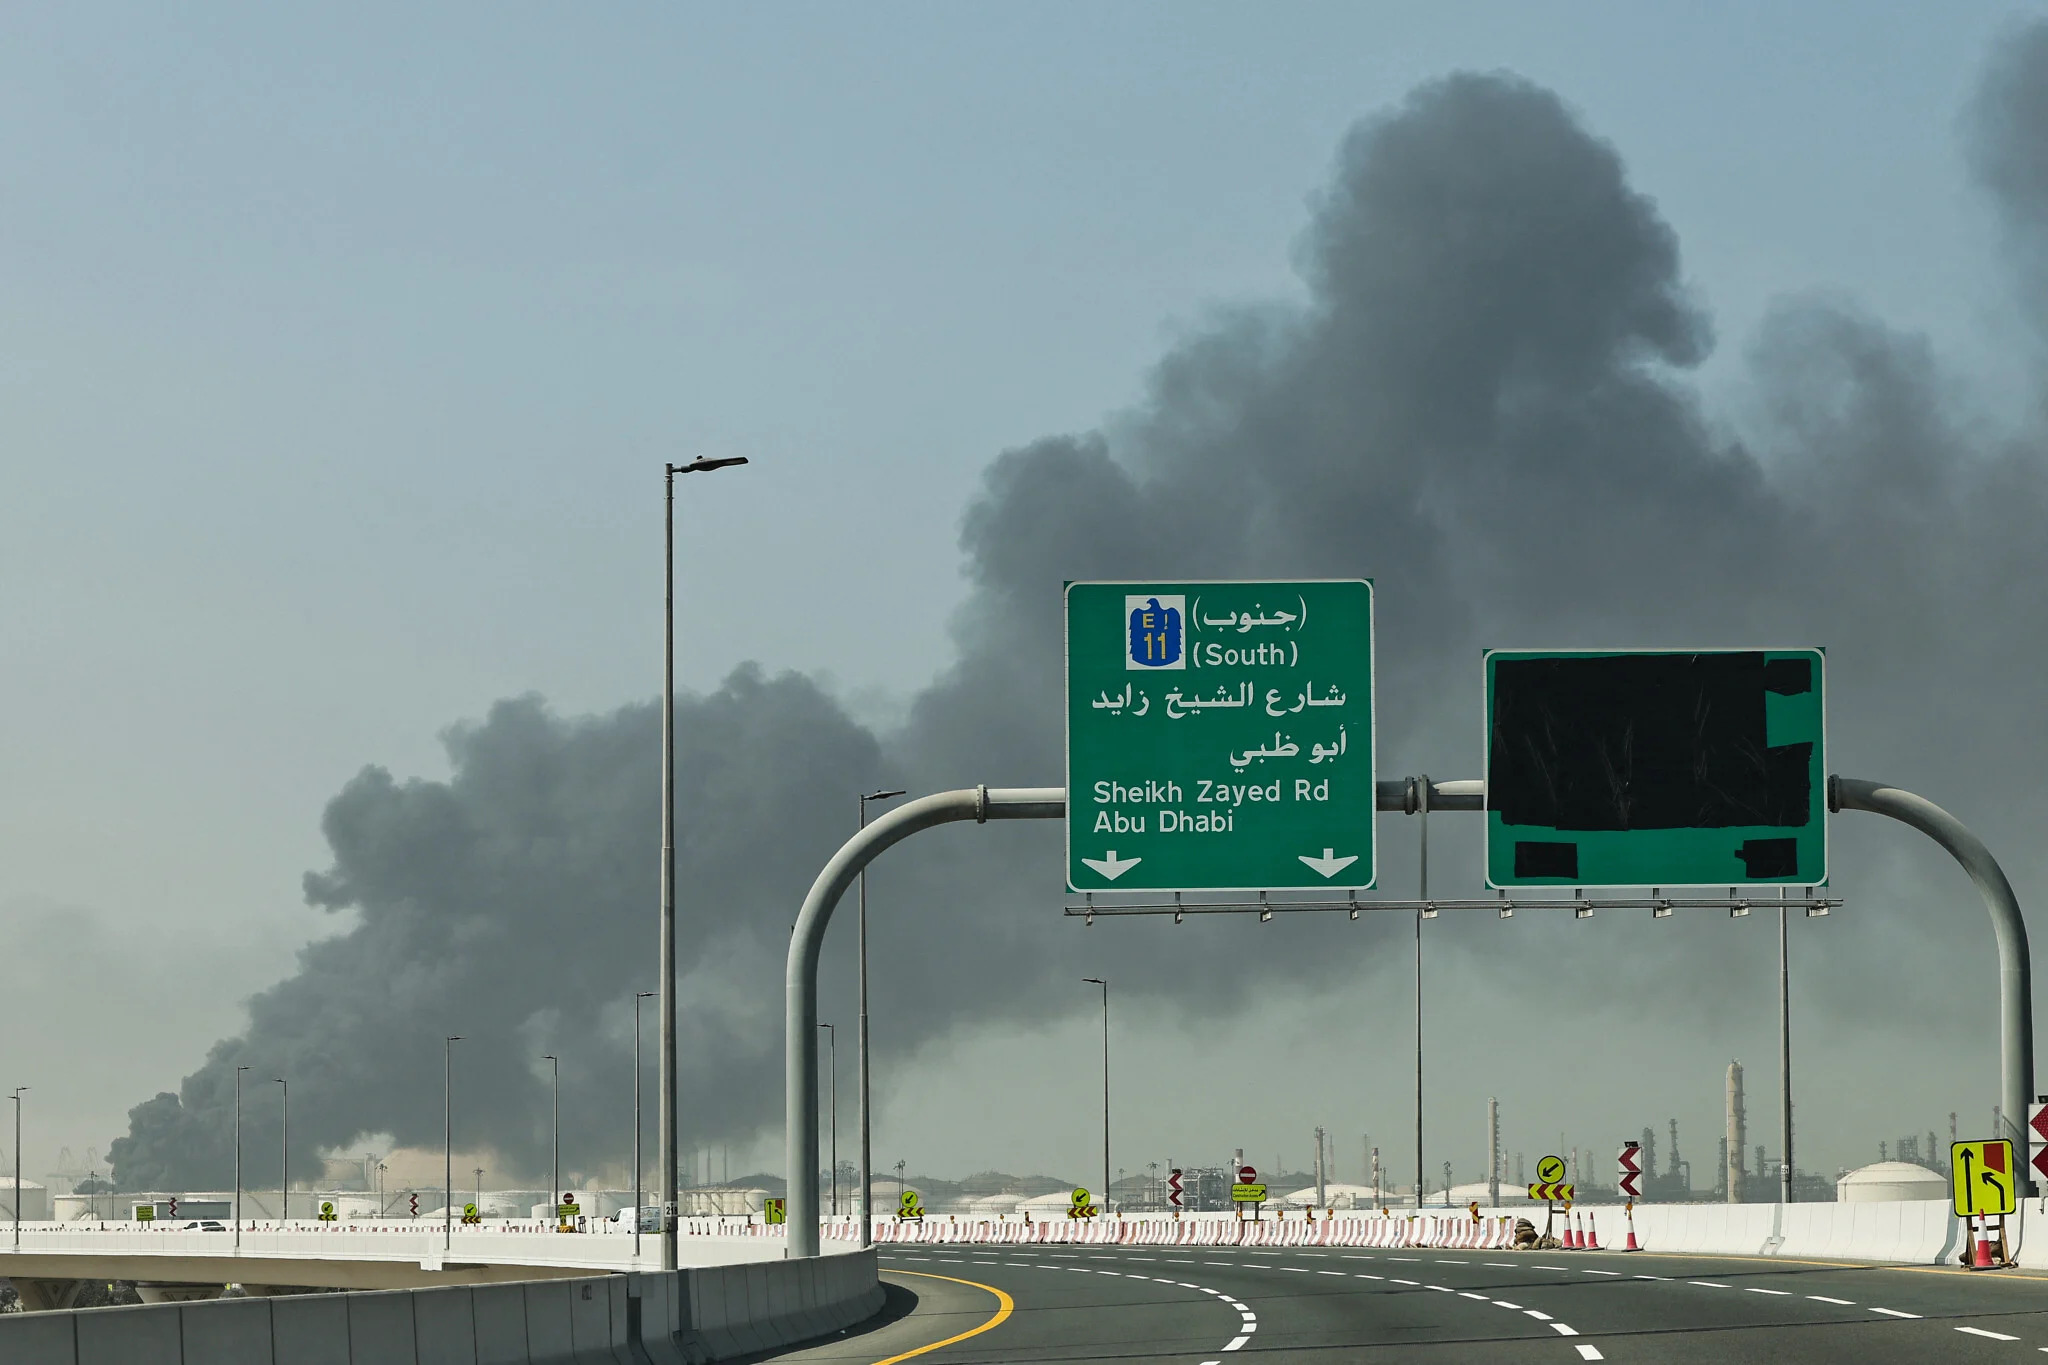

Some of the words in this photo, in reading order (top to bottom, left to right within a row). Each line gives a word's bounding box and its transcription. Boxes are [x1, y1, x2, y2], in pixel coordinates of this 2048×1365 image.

[1143, 614, 1154, 628] E
[1193, 595, 1306, 633] (جنوب)
[1144, 633, 1165, 659] 11
[1193, 641, 1297, 667] (South)
[1092, 682, 1149, 716] زايد
[1165, 681, 1253, 719] الشيخ
[1266, 681, 1346, 716] شارع
[1230, 731, 1299, 773] ظبي
[1309, 724, 1346, 763] أبو
[1094, 780, 1182, 803] Sheikh
[1197, 780, 1280, 807] Zayed
[1296, 779, 1328, 801] Rd
[1094, 811, 1145, 833] Abu
[1160, 809, 1232, 832] Dhabi
